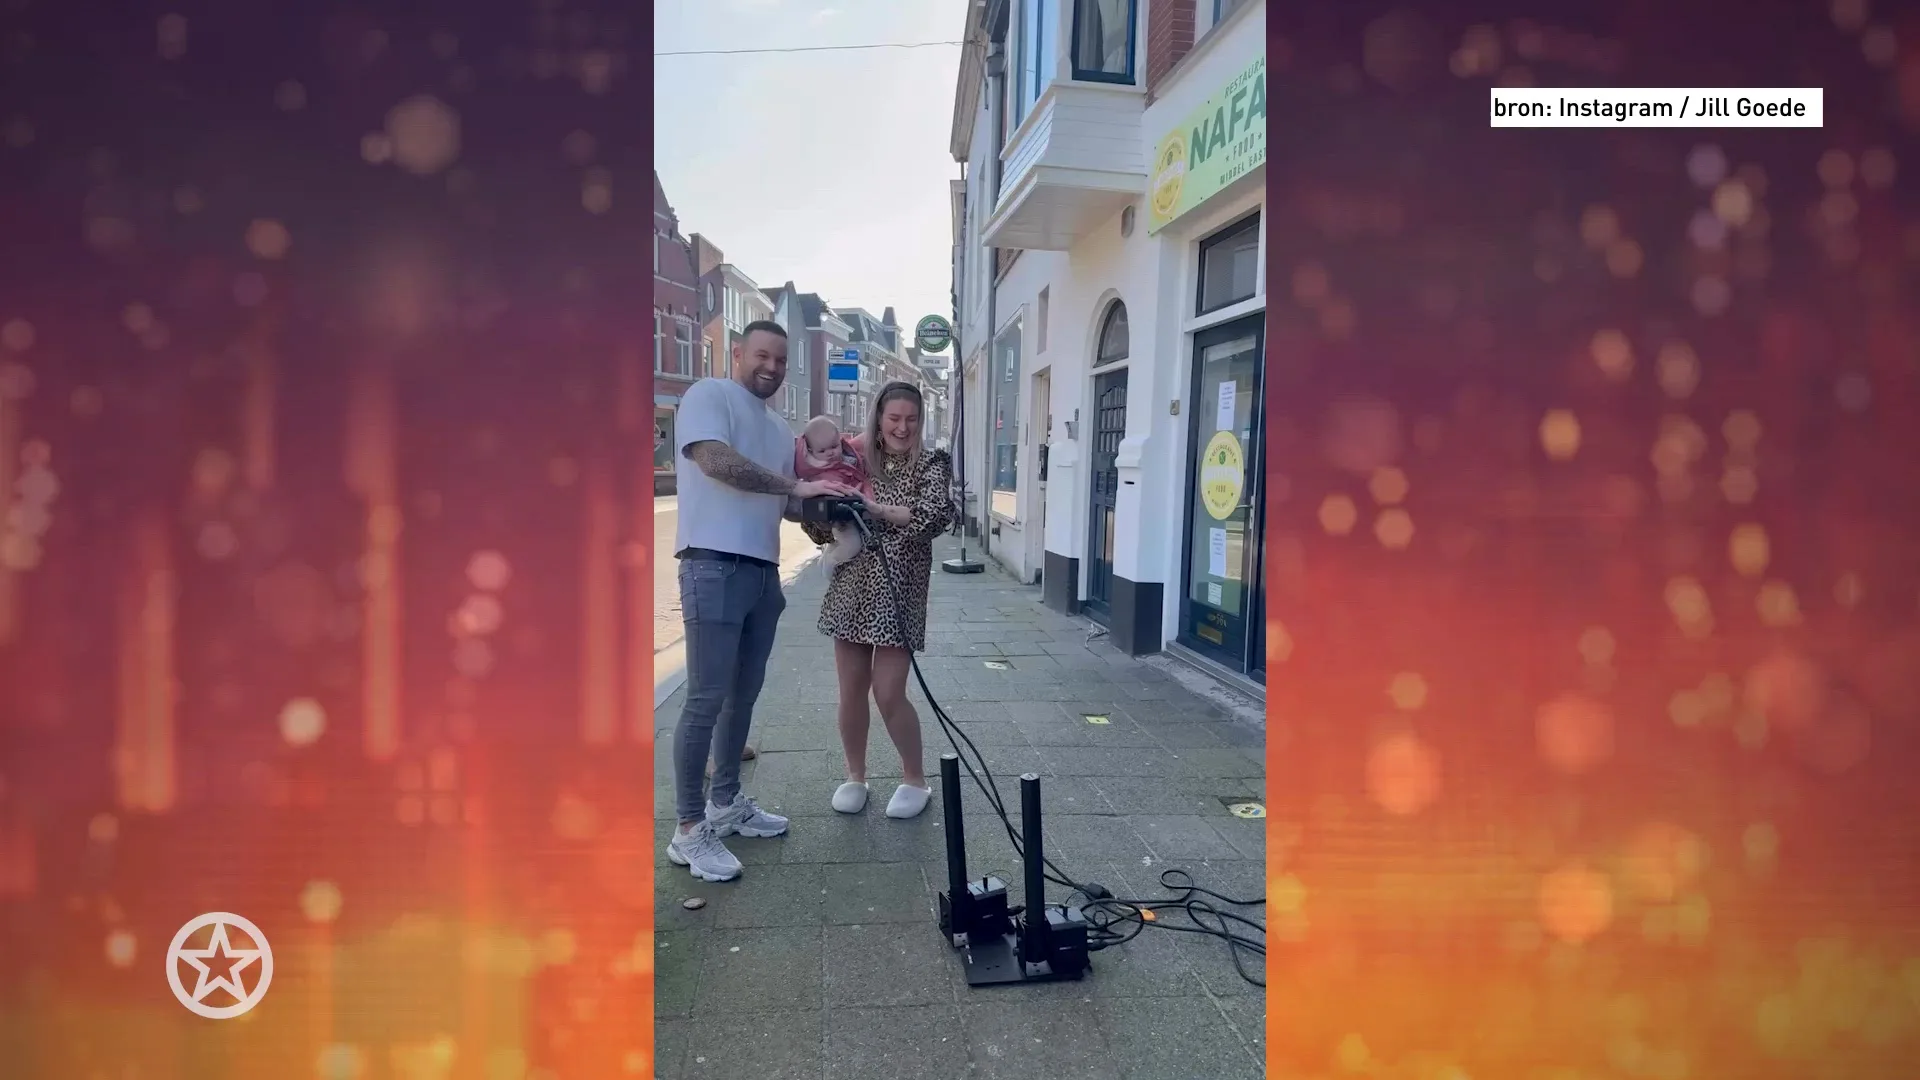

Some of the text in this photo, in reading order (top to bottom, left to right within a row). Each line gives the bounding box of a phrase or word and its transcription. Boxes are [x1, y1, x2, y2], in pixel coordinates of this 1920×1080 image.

[1189, 72, 1267, 171] NAFA
[1233, 133, 1255, 160] FOOD
[1220, 161, 1244, 185] MIDDEL
